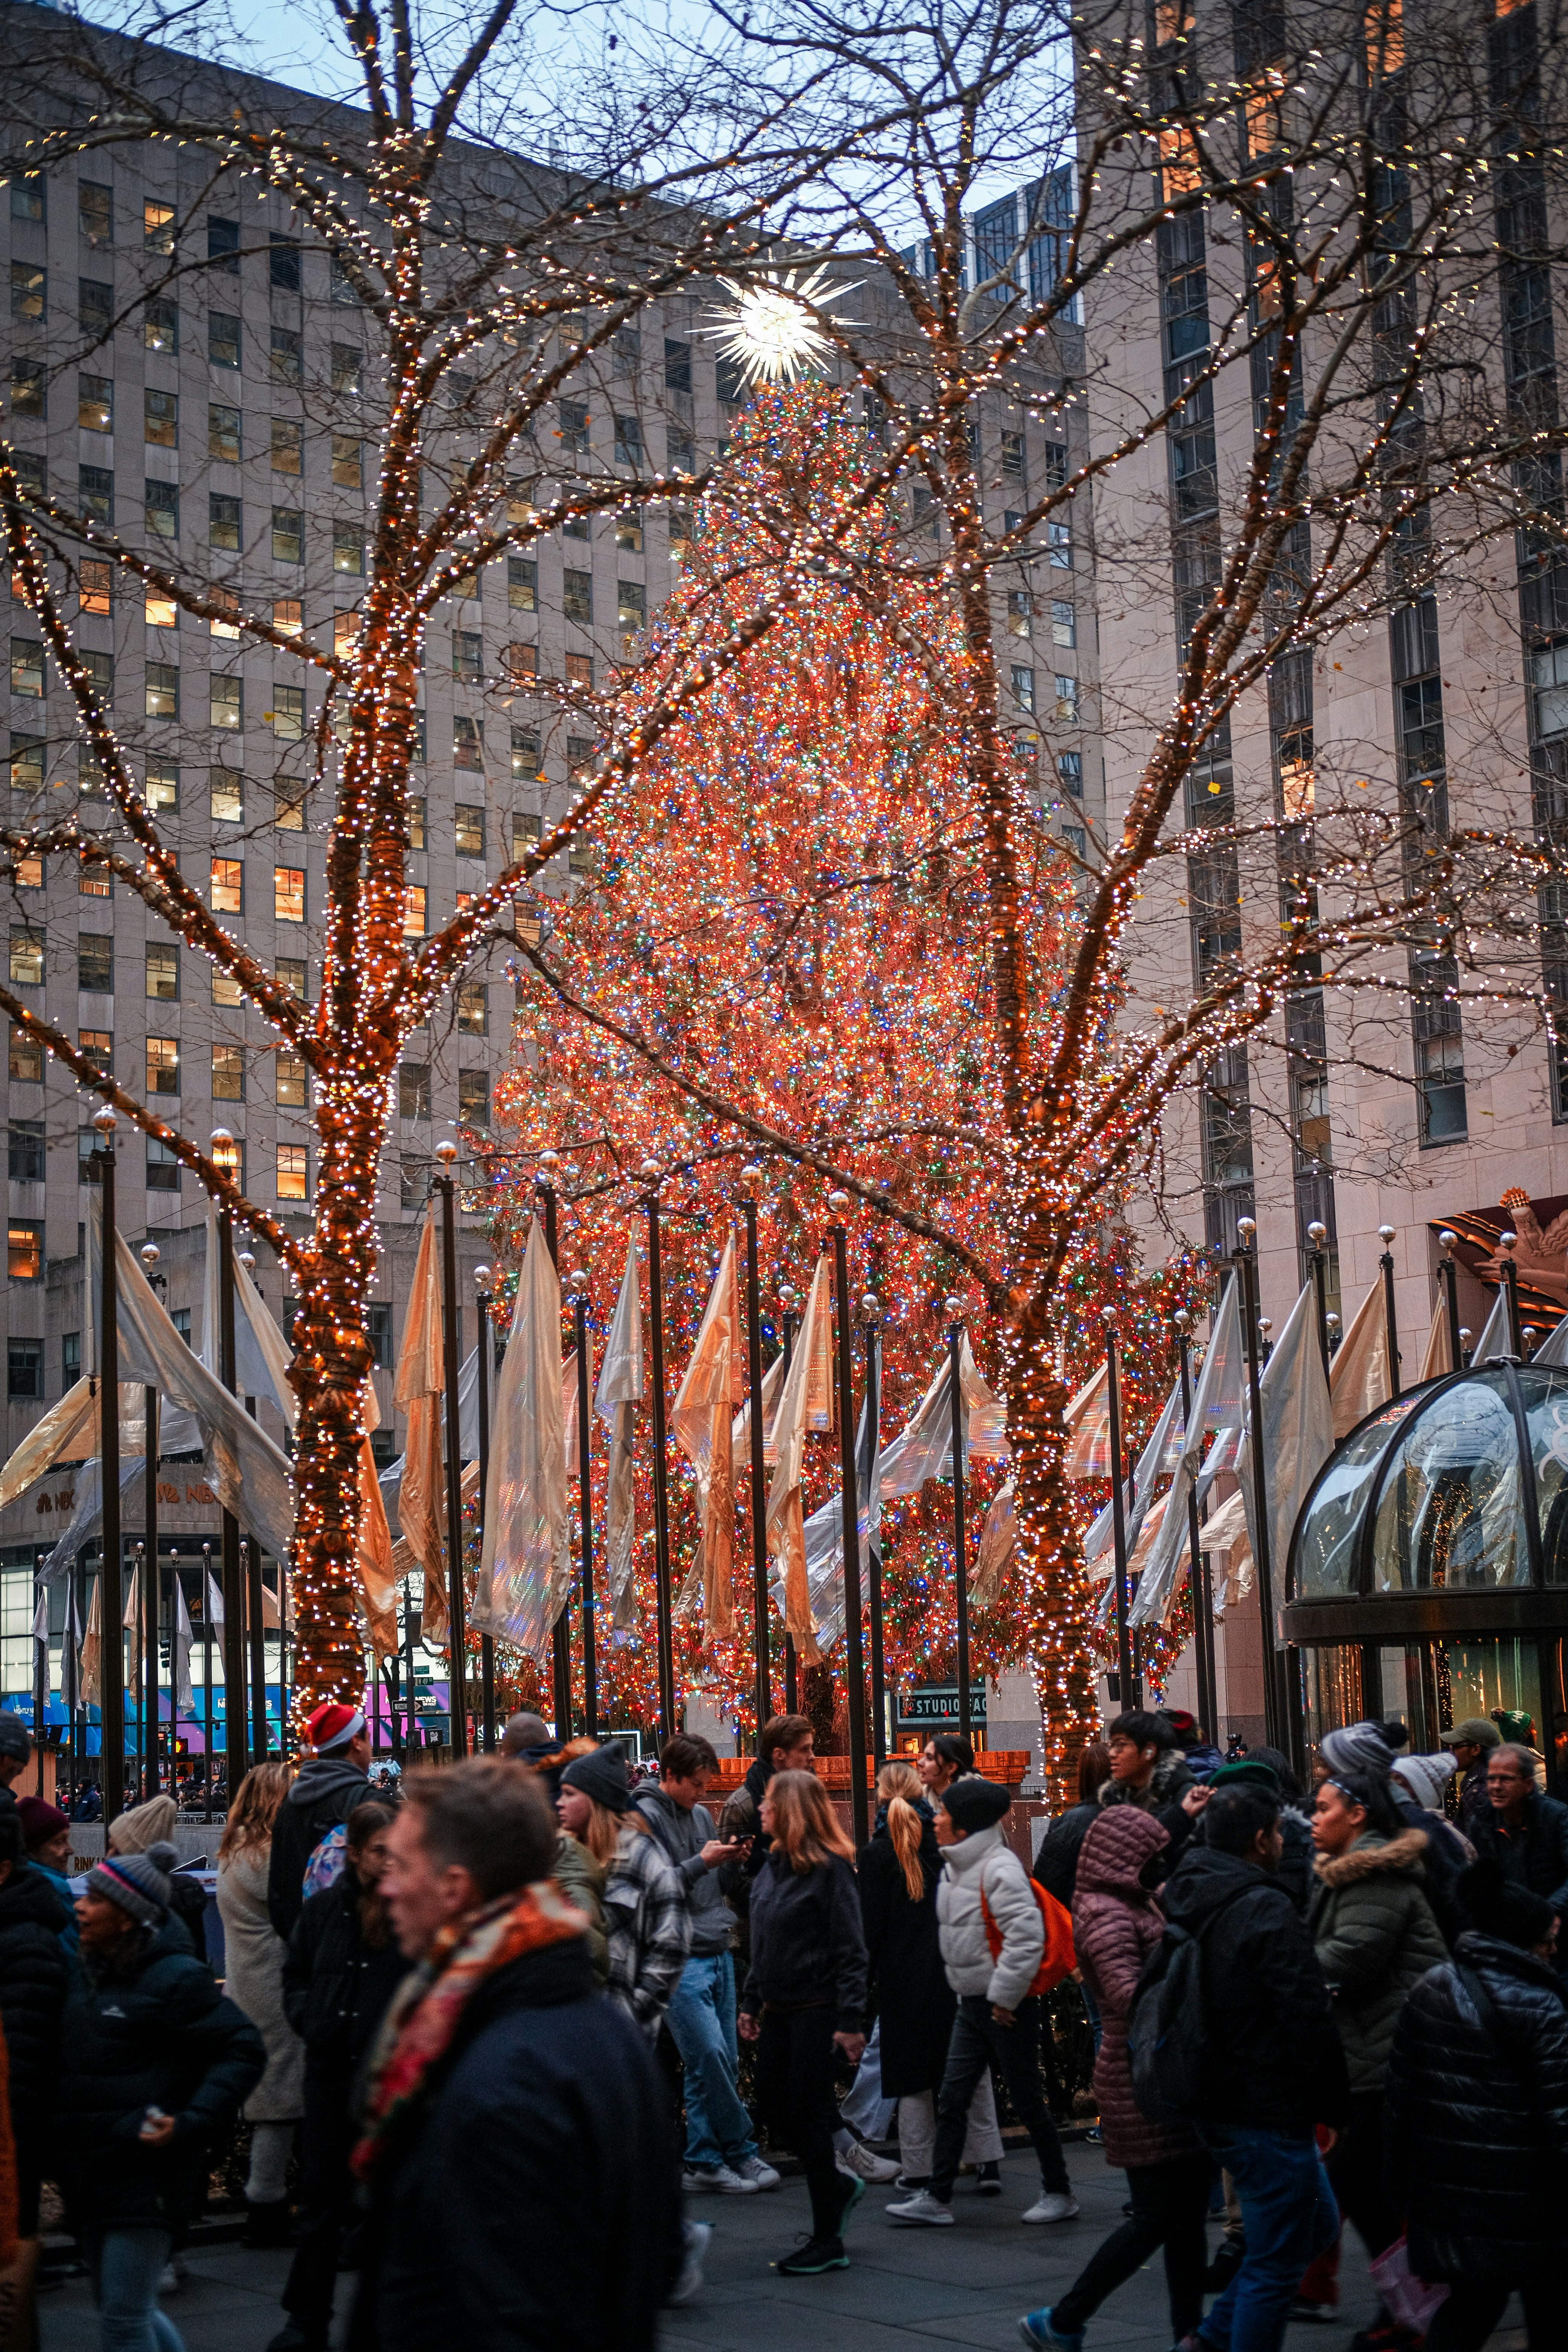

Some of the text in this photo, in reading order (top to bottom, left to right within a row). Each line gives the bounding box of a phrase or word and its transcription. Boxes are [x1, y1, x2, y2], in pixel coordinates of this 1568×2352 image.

[55, 1488, 74, 1511] NBC
[917, 1698, 959, 1713] STUDIO
[74, 1857, 95, 1871] RINK
